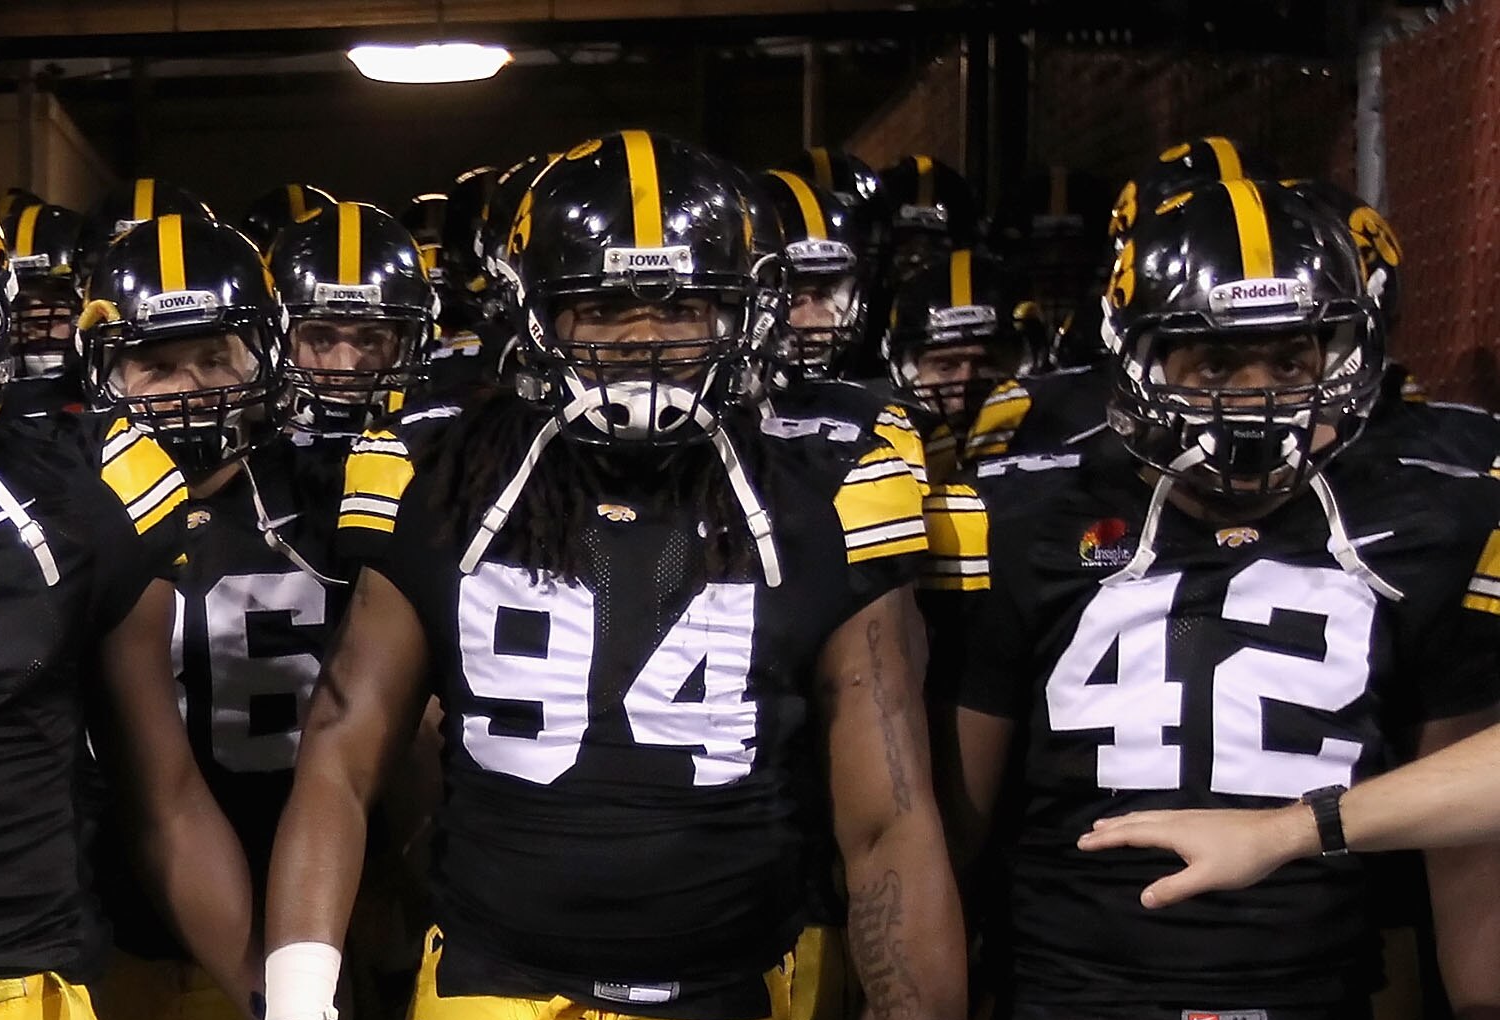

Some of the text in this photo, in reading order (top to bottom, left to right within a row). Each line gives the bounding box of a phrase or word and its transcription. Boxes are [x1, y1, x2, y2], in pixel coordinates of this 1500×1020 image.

[629, 255, 670, 266] IOWA
[333, 290, 365, 299] IOWA
[1232, 282, 1287, 299] Riddell
[160, 296, 196, 308] IOWA
[457, 560, 757, 787] 94
[1045, 558, 1379, 800] 42
